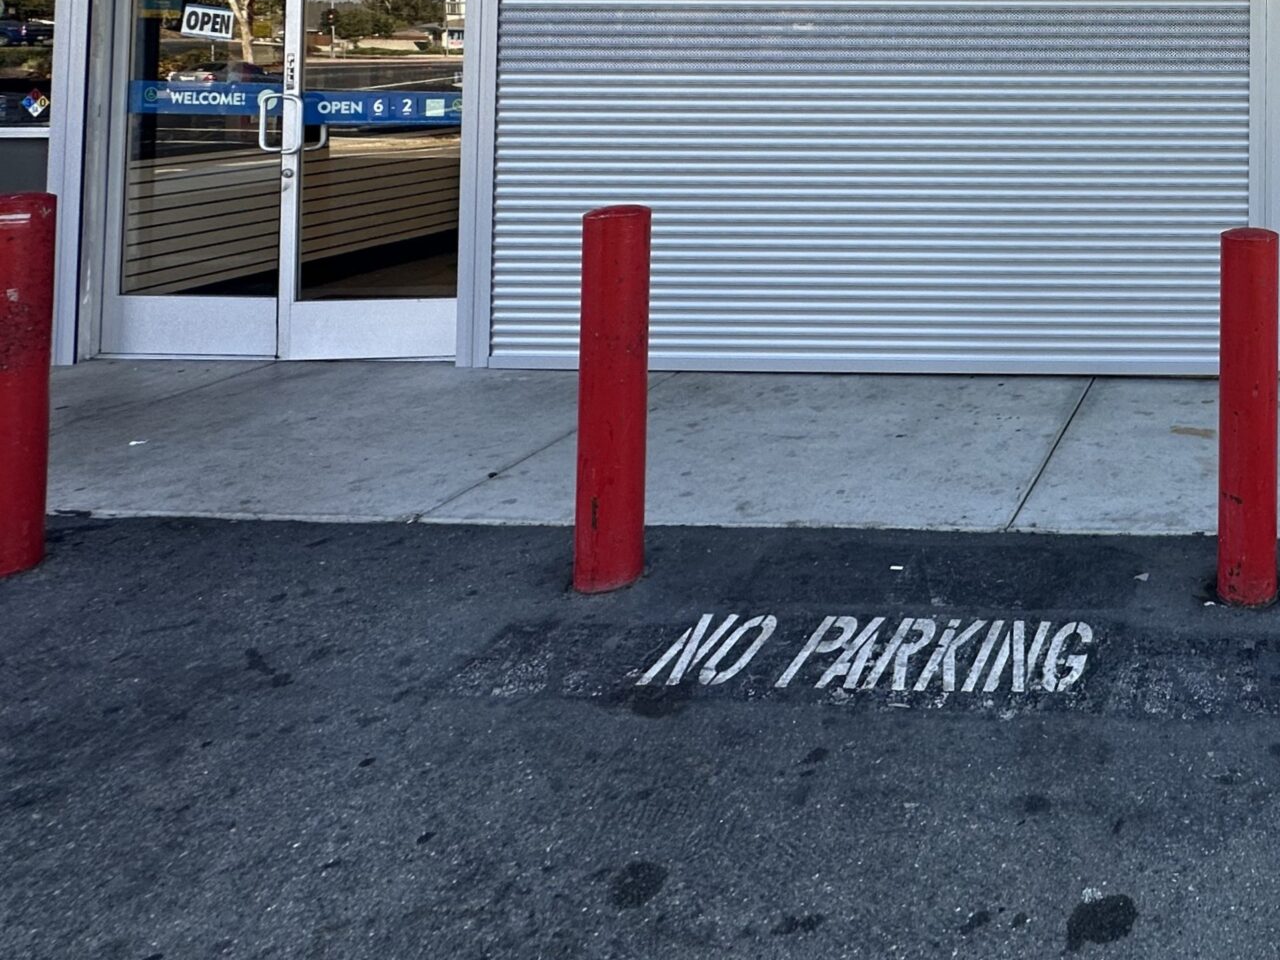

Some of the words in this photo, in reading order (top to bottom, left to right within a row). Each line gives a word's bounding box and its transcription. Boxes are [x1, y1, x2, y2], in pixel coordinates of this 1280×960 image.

[185, 10, 231, 35] OPEN
[170, 91, 246, 106] WELCOME!
[317, 100, 363, 114] OPEN
[373, 98, 384, 112] 6
[402, 98, 412, 112] 2
[636, 613, 778, 687] NO
[775, 615, 1094, 693] PARKING
